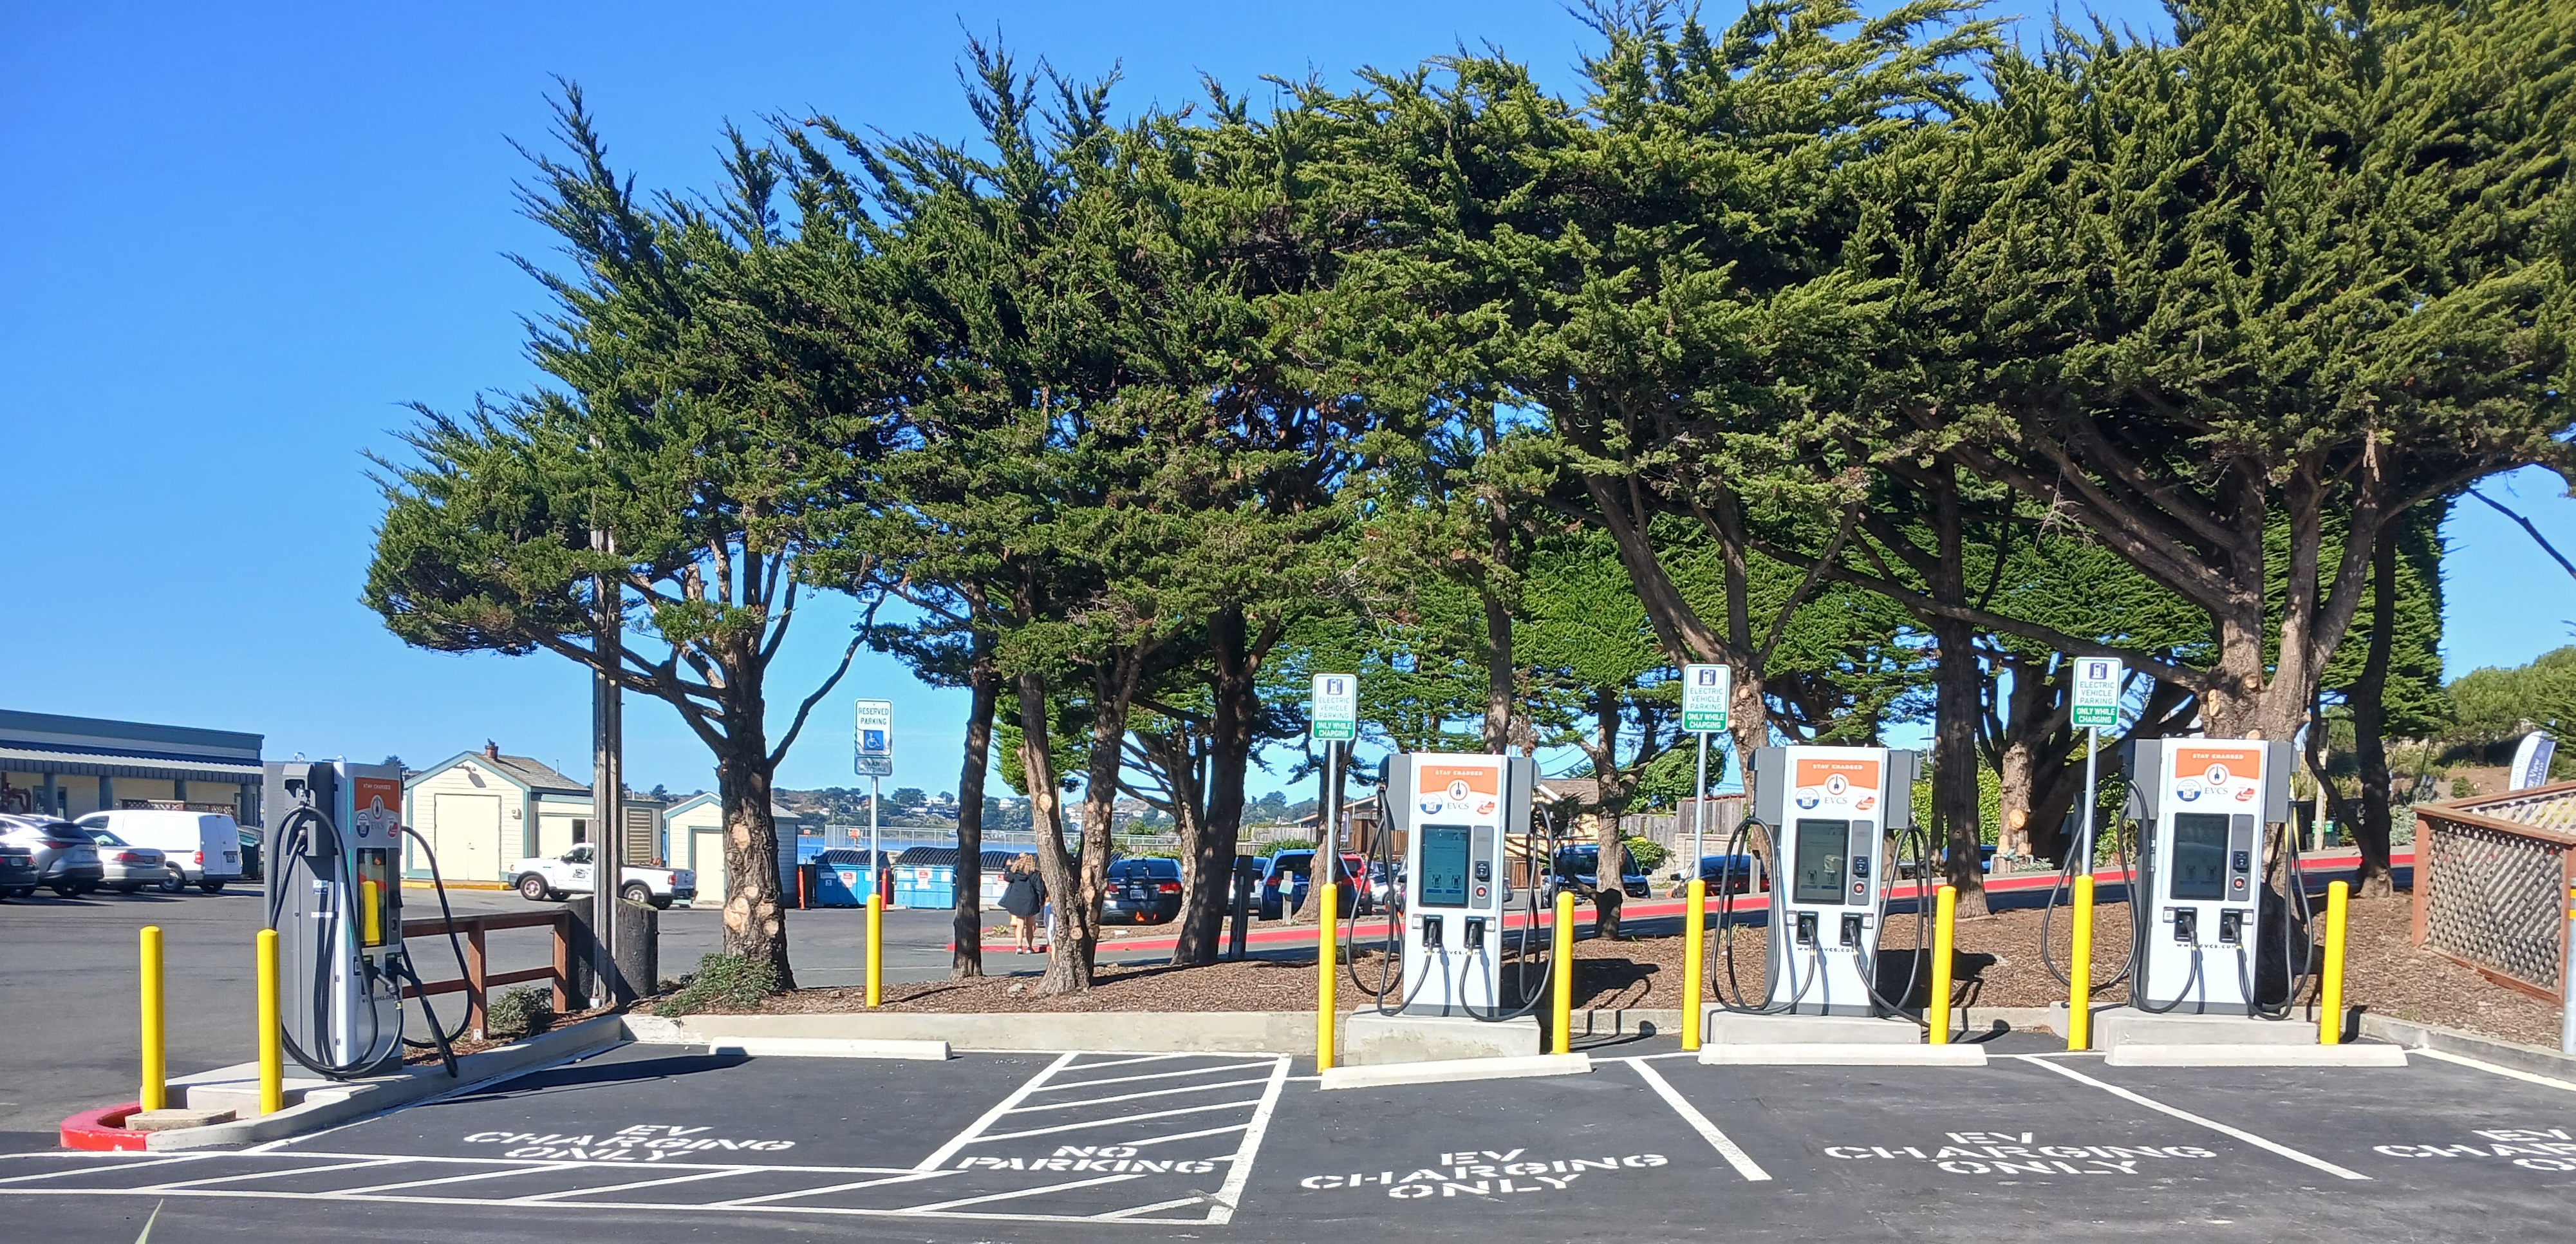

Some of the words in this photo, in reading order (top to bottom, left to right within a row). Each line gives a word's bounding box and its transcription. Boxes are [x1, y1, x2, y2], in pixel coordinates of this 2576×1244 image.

[2080, 681, 2115, 689] ELECTRIC
[858, 707, 890, 715] RESERVED
[860, 717, 887, 726] PARKING
[2528, 758, 2539, 778] View
[1446, 802, 1470, 810] EVCS
[616, 1124, 714, 1136] EV
[2471, 1129, 2573, 1142] EV
[463, 1131, 796, 1151] CHARGING
[1945, 1131, 2033, 1144] EV
[504, 1147, 695, 1162] ONLY
[1052, 1145, 1139, 1158] NO
[1441, 1148, 1528, 1165] EV
[1824, 1145, 2217, 1159] CHARGING
[956, 1156, 1215, 1174] PARKING
[1300, 1154, 1669, 1190] CHARGING
[1936, 1160, 2139, 1175] ONLY
[1388, 1173, 1582, 1199] ONLY
